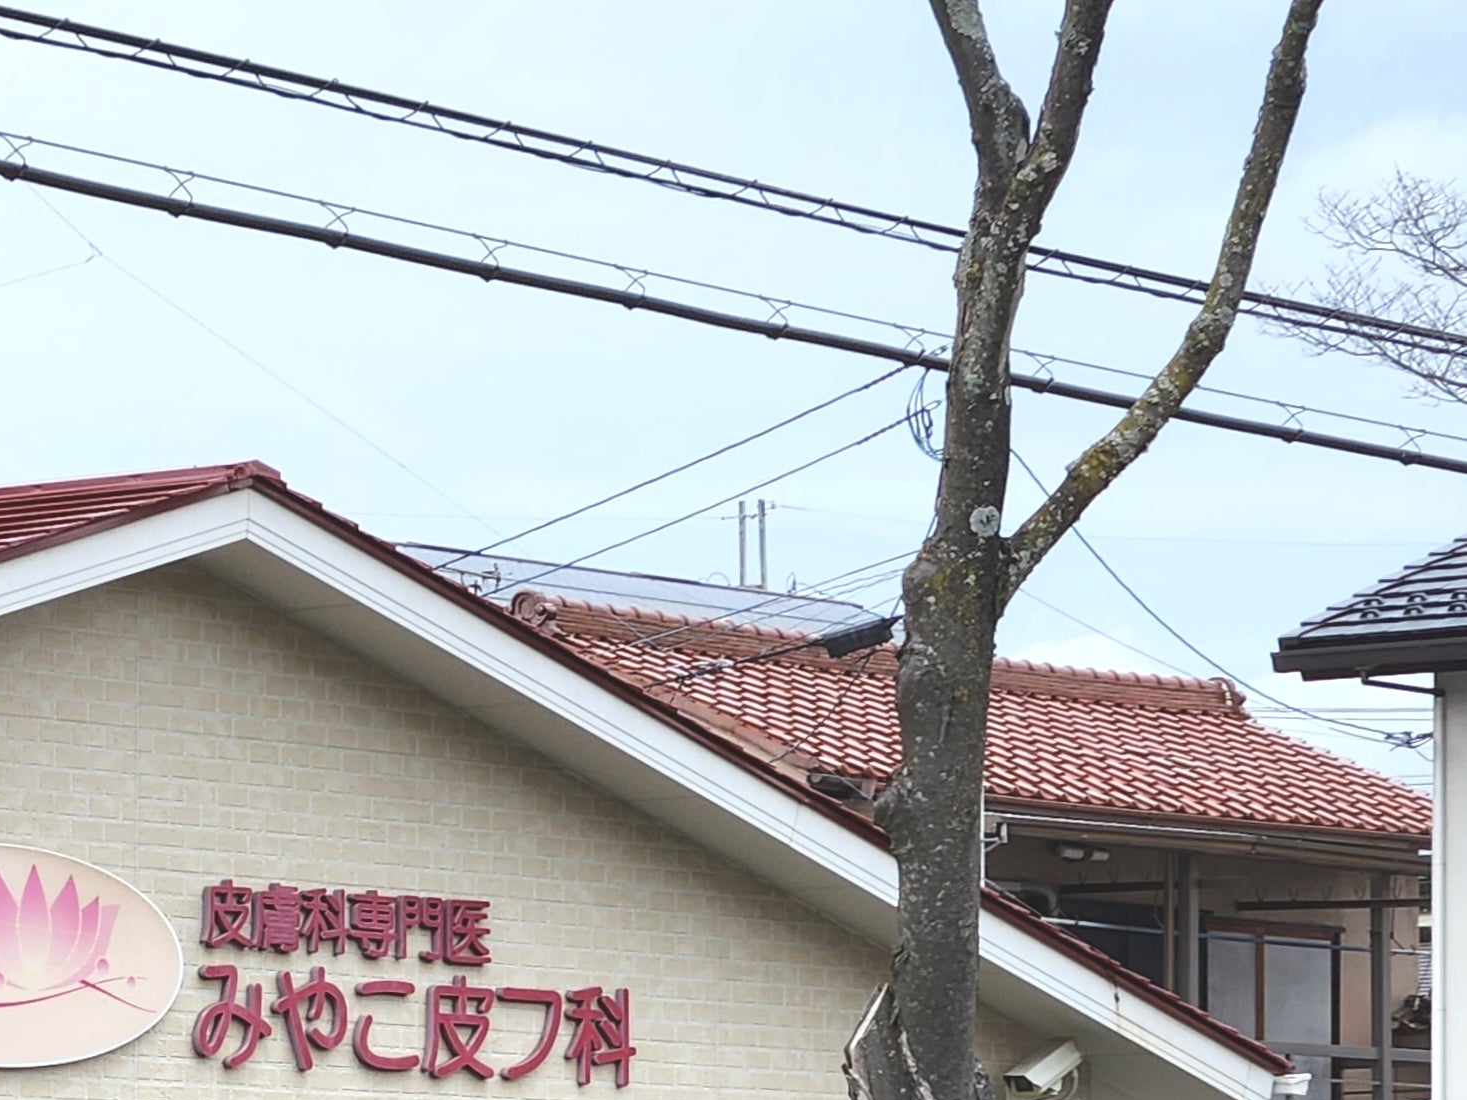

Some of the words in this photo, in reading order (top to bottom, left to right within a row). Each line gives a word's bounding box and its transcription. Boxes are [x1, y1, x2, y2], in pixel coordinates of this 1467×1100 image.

[200, 879, 493, 966] 皮膚科専門医
[193, 963, 637, 1089] みやこ皮フ科
